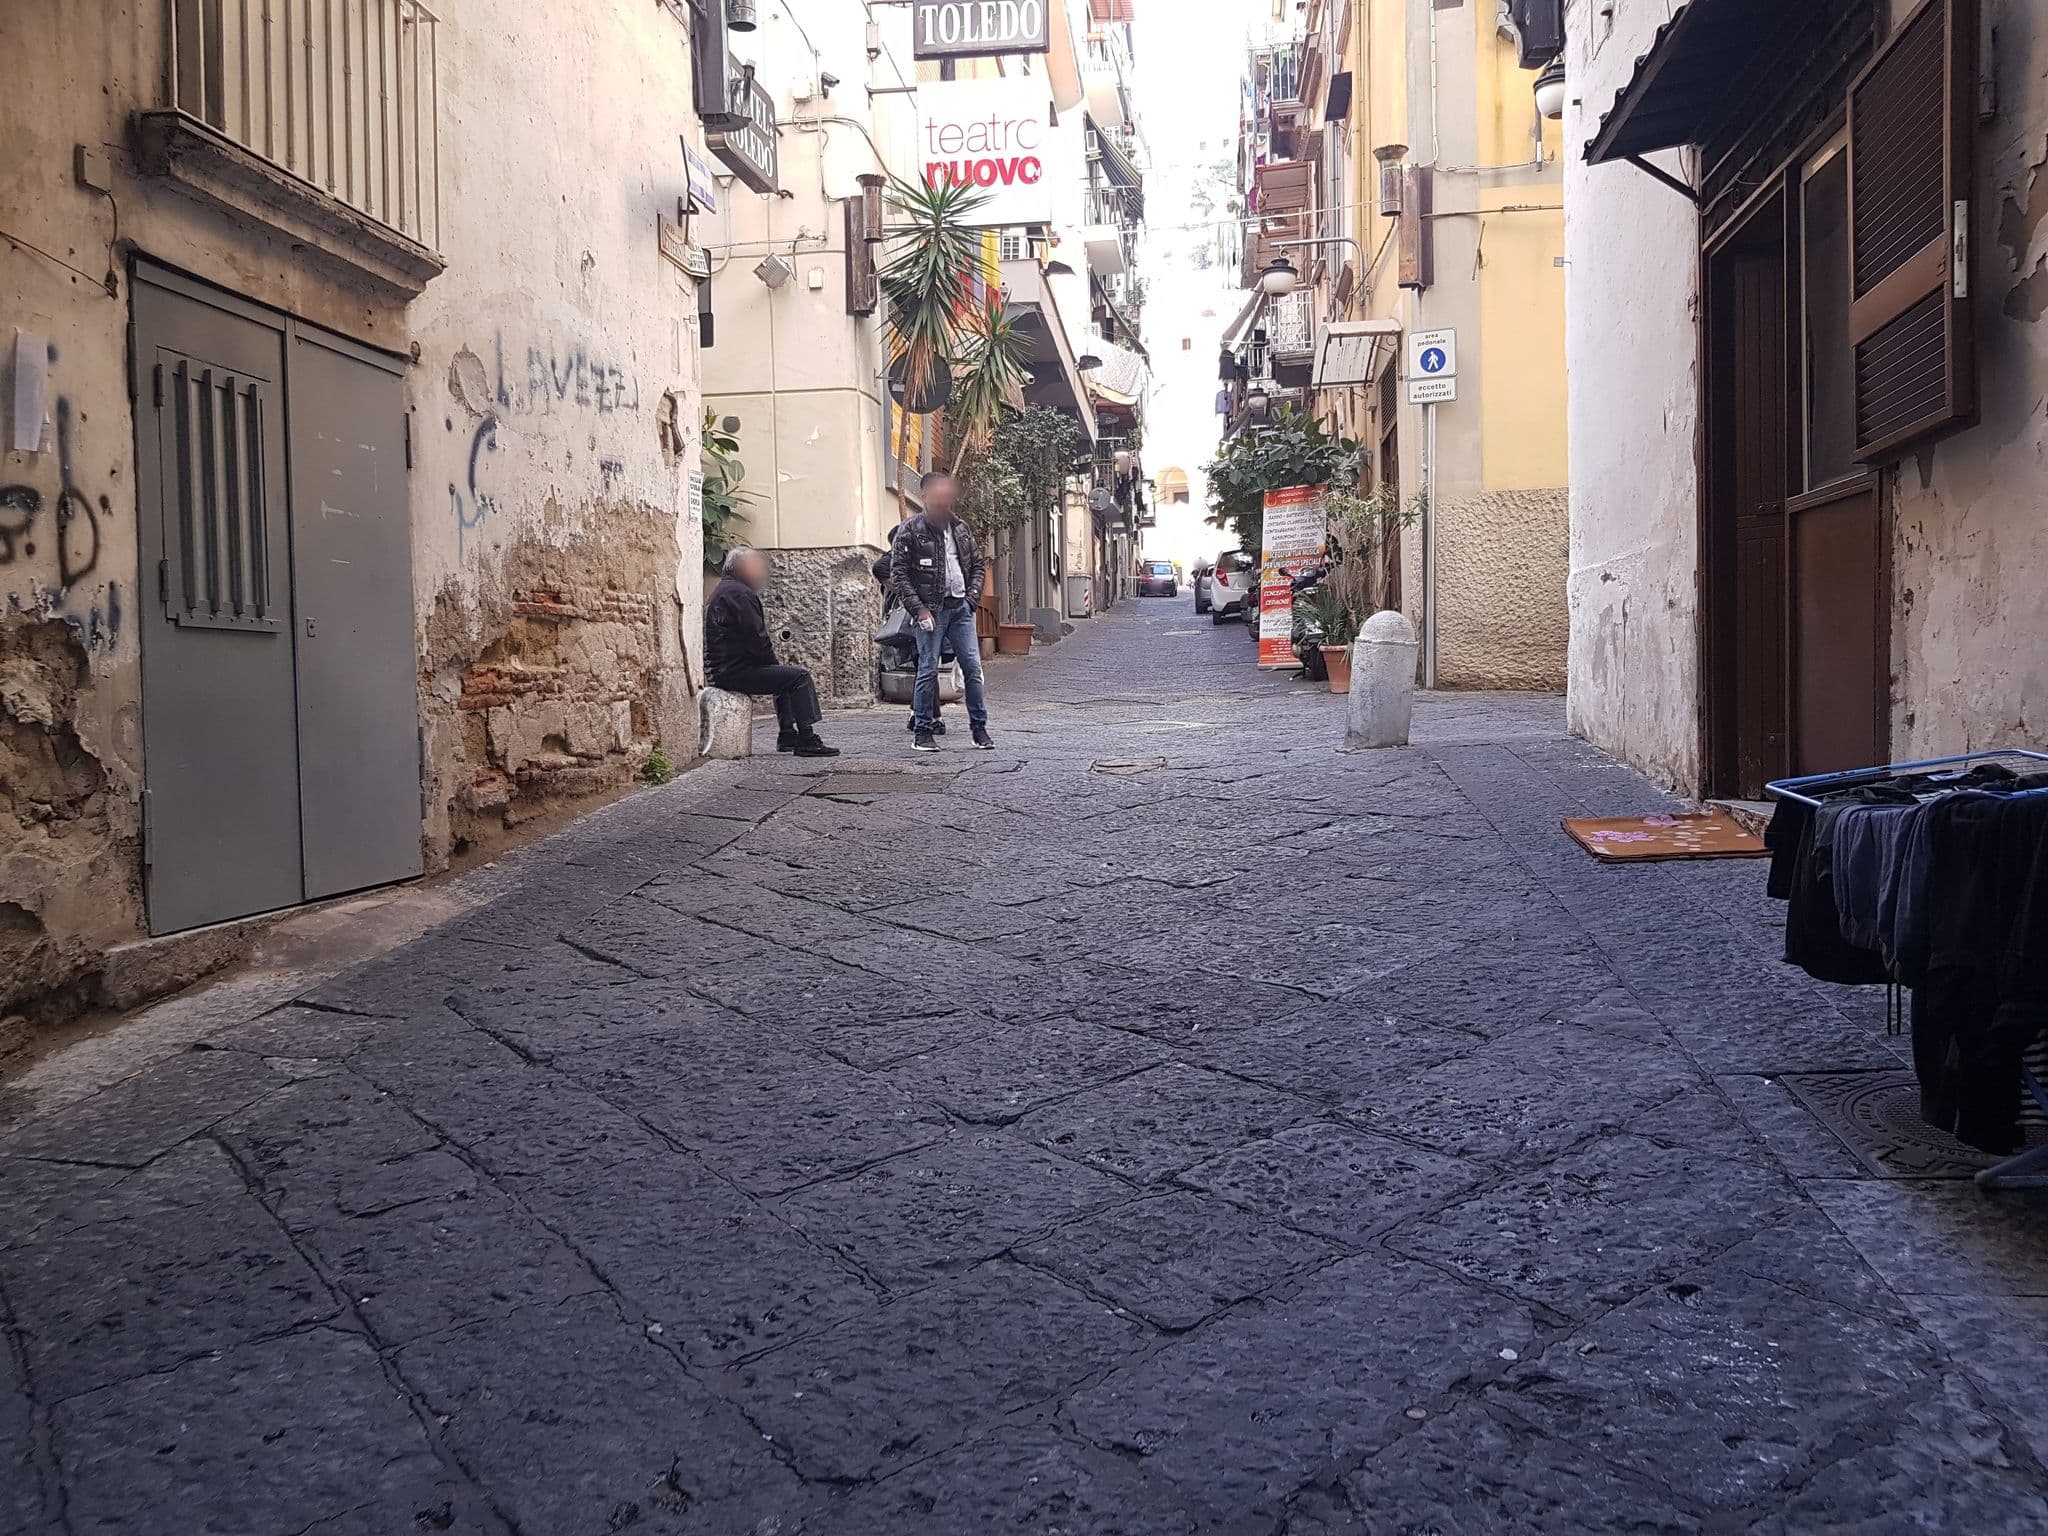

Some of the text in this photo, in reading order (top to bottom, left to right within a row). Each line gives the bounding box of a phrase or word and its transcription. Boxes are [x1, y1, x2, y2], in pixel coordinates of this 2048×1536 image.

[919, 0, 1042, 45] TOLEDO
[926, 156, 1042, 190] nuovo
[1417, 338, 1446, 347] pedonale
[1418, 383, 1446, 391] eccetto
[1413, 389, 1452, 399] autorizzati
